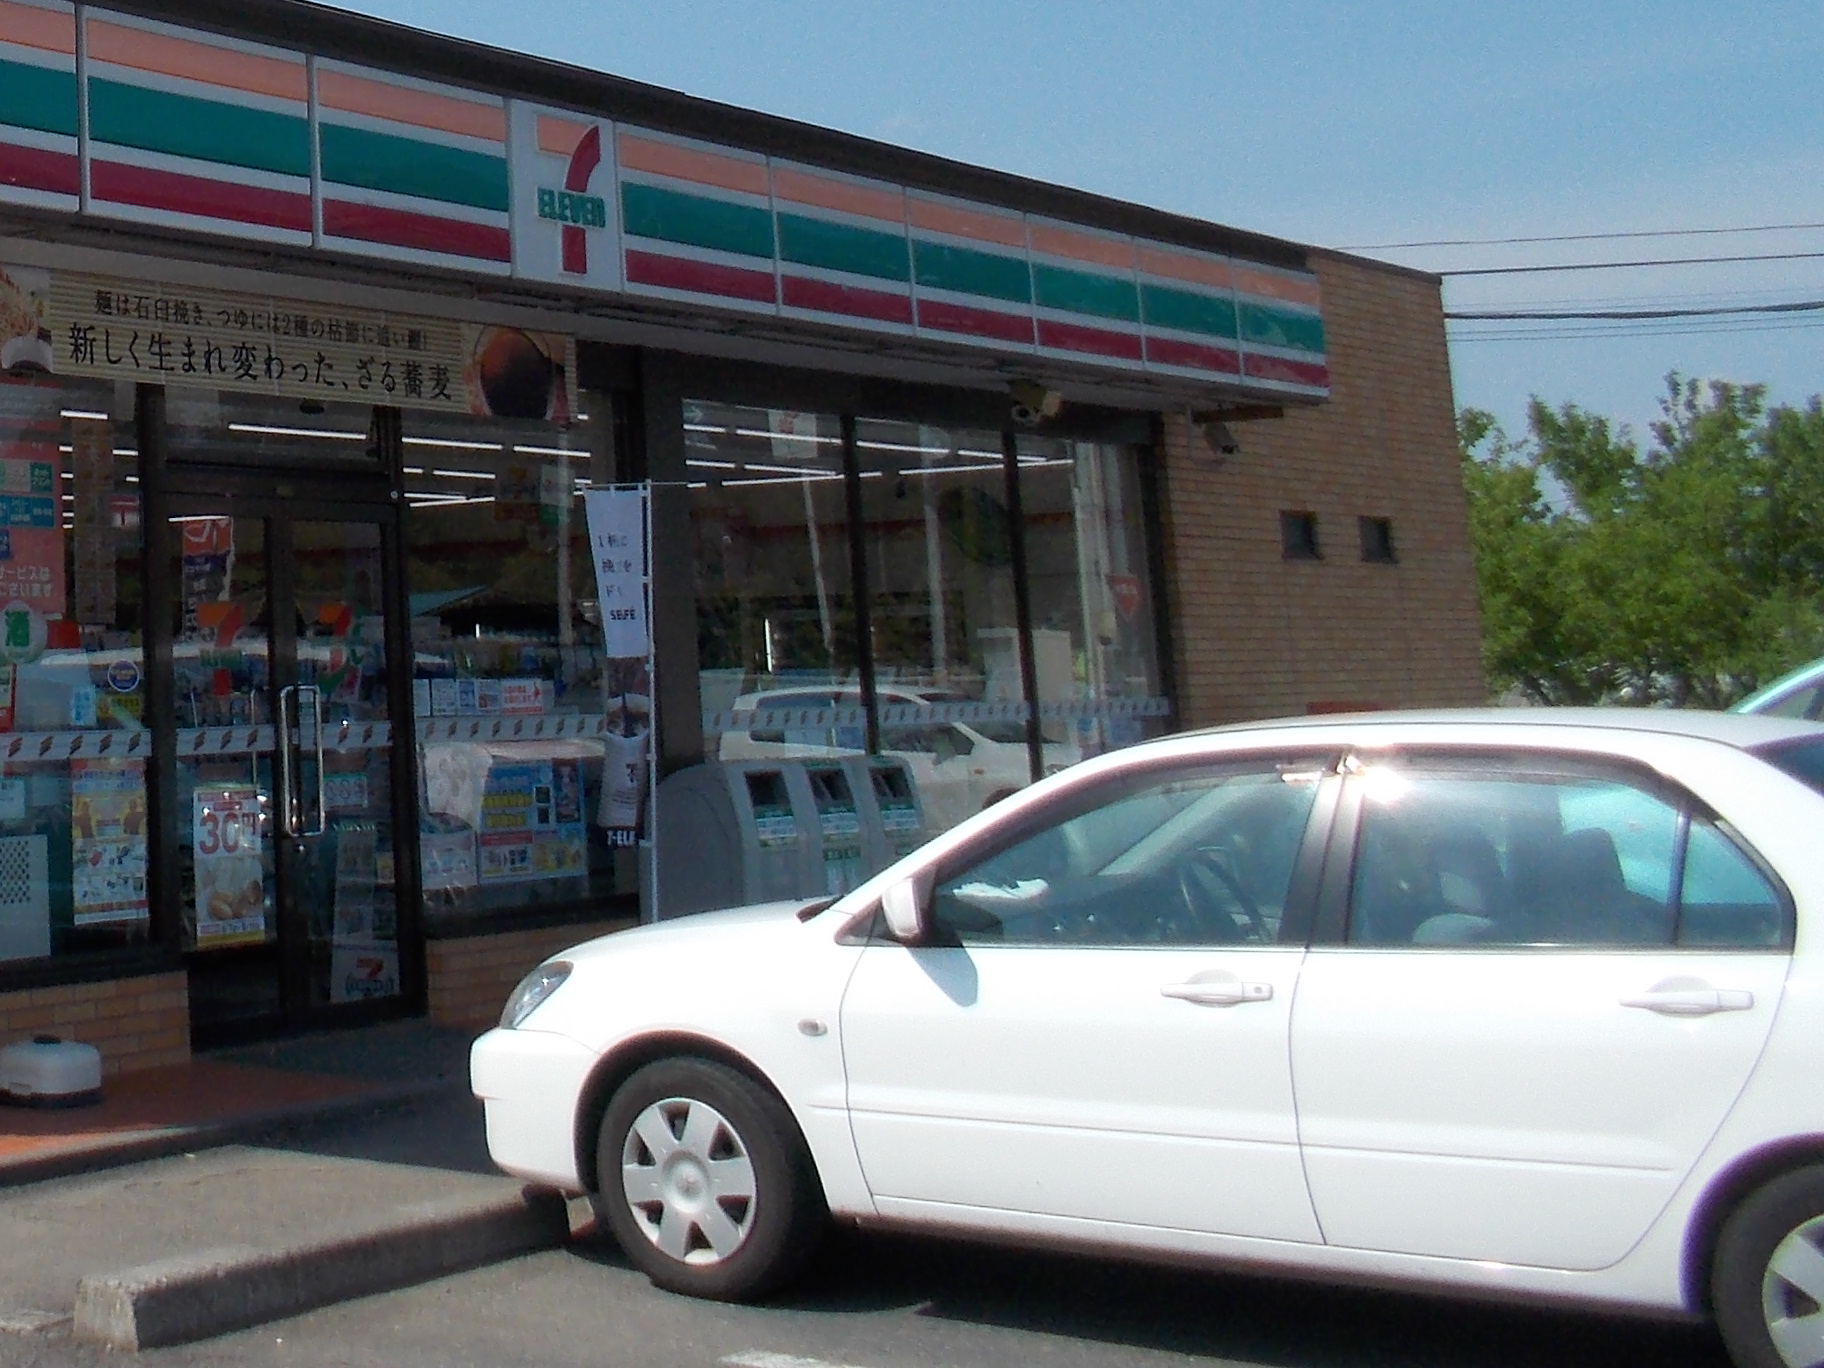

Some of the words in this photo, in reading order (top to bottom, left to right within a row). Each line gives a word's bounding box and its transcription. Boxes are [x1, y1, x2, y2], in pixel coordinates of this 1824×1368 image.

[68, 321, 452, 401] 新しく生まれ変わった、ざる蕎麦
